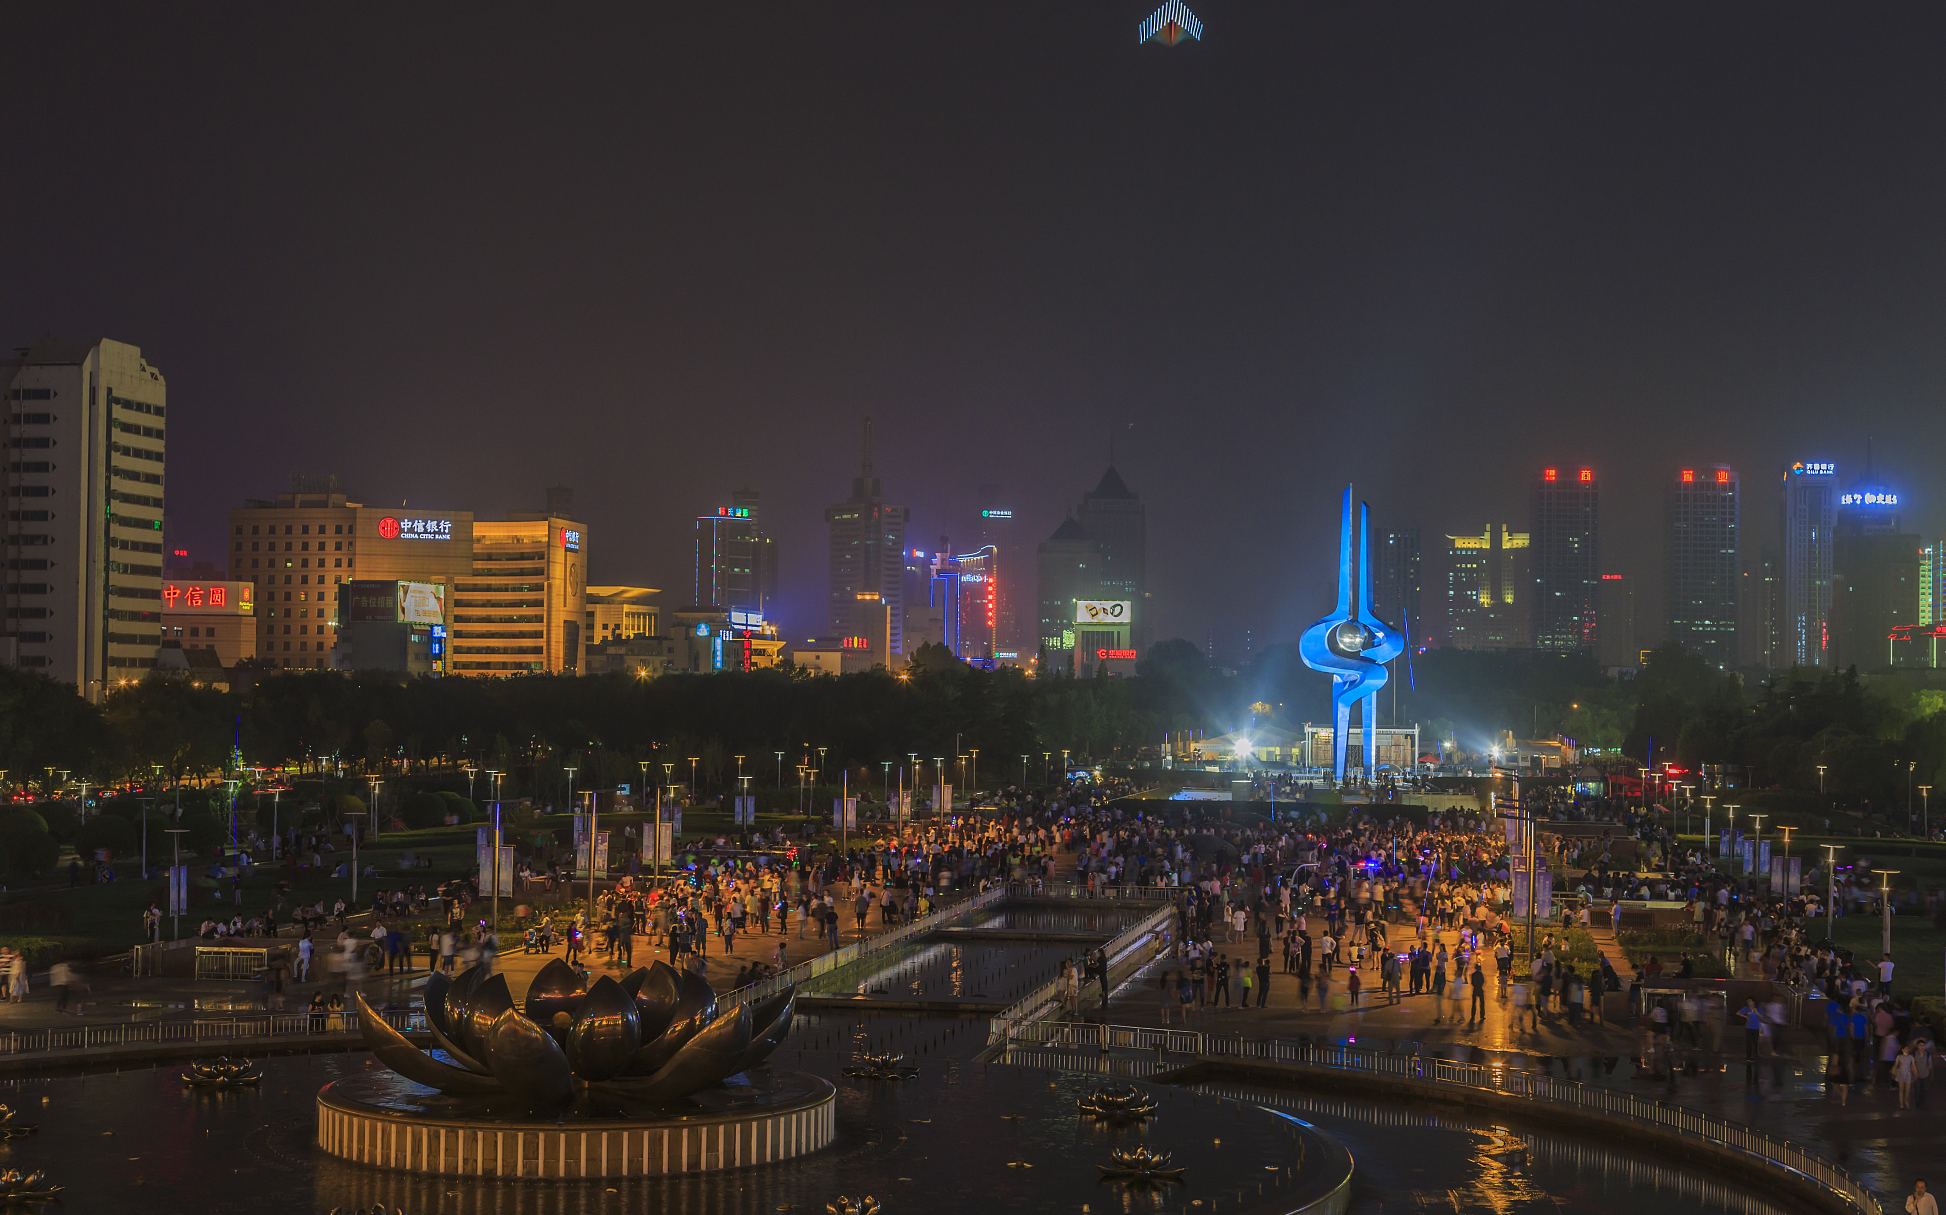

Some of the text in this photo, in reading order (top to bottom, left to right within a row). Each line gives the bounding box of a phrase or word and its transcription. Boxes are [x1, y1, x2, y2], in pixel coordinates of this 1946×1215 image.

[400, 519, 452, 533] 中信银行
[352, 595, 395, 608] 广告位招租
